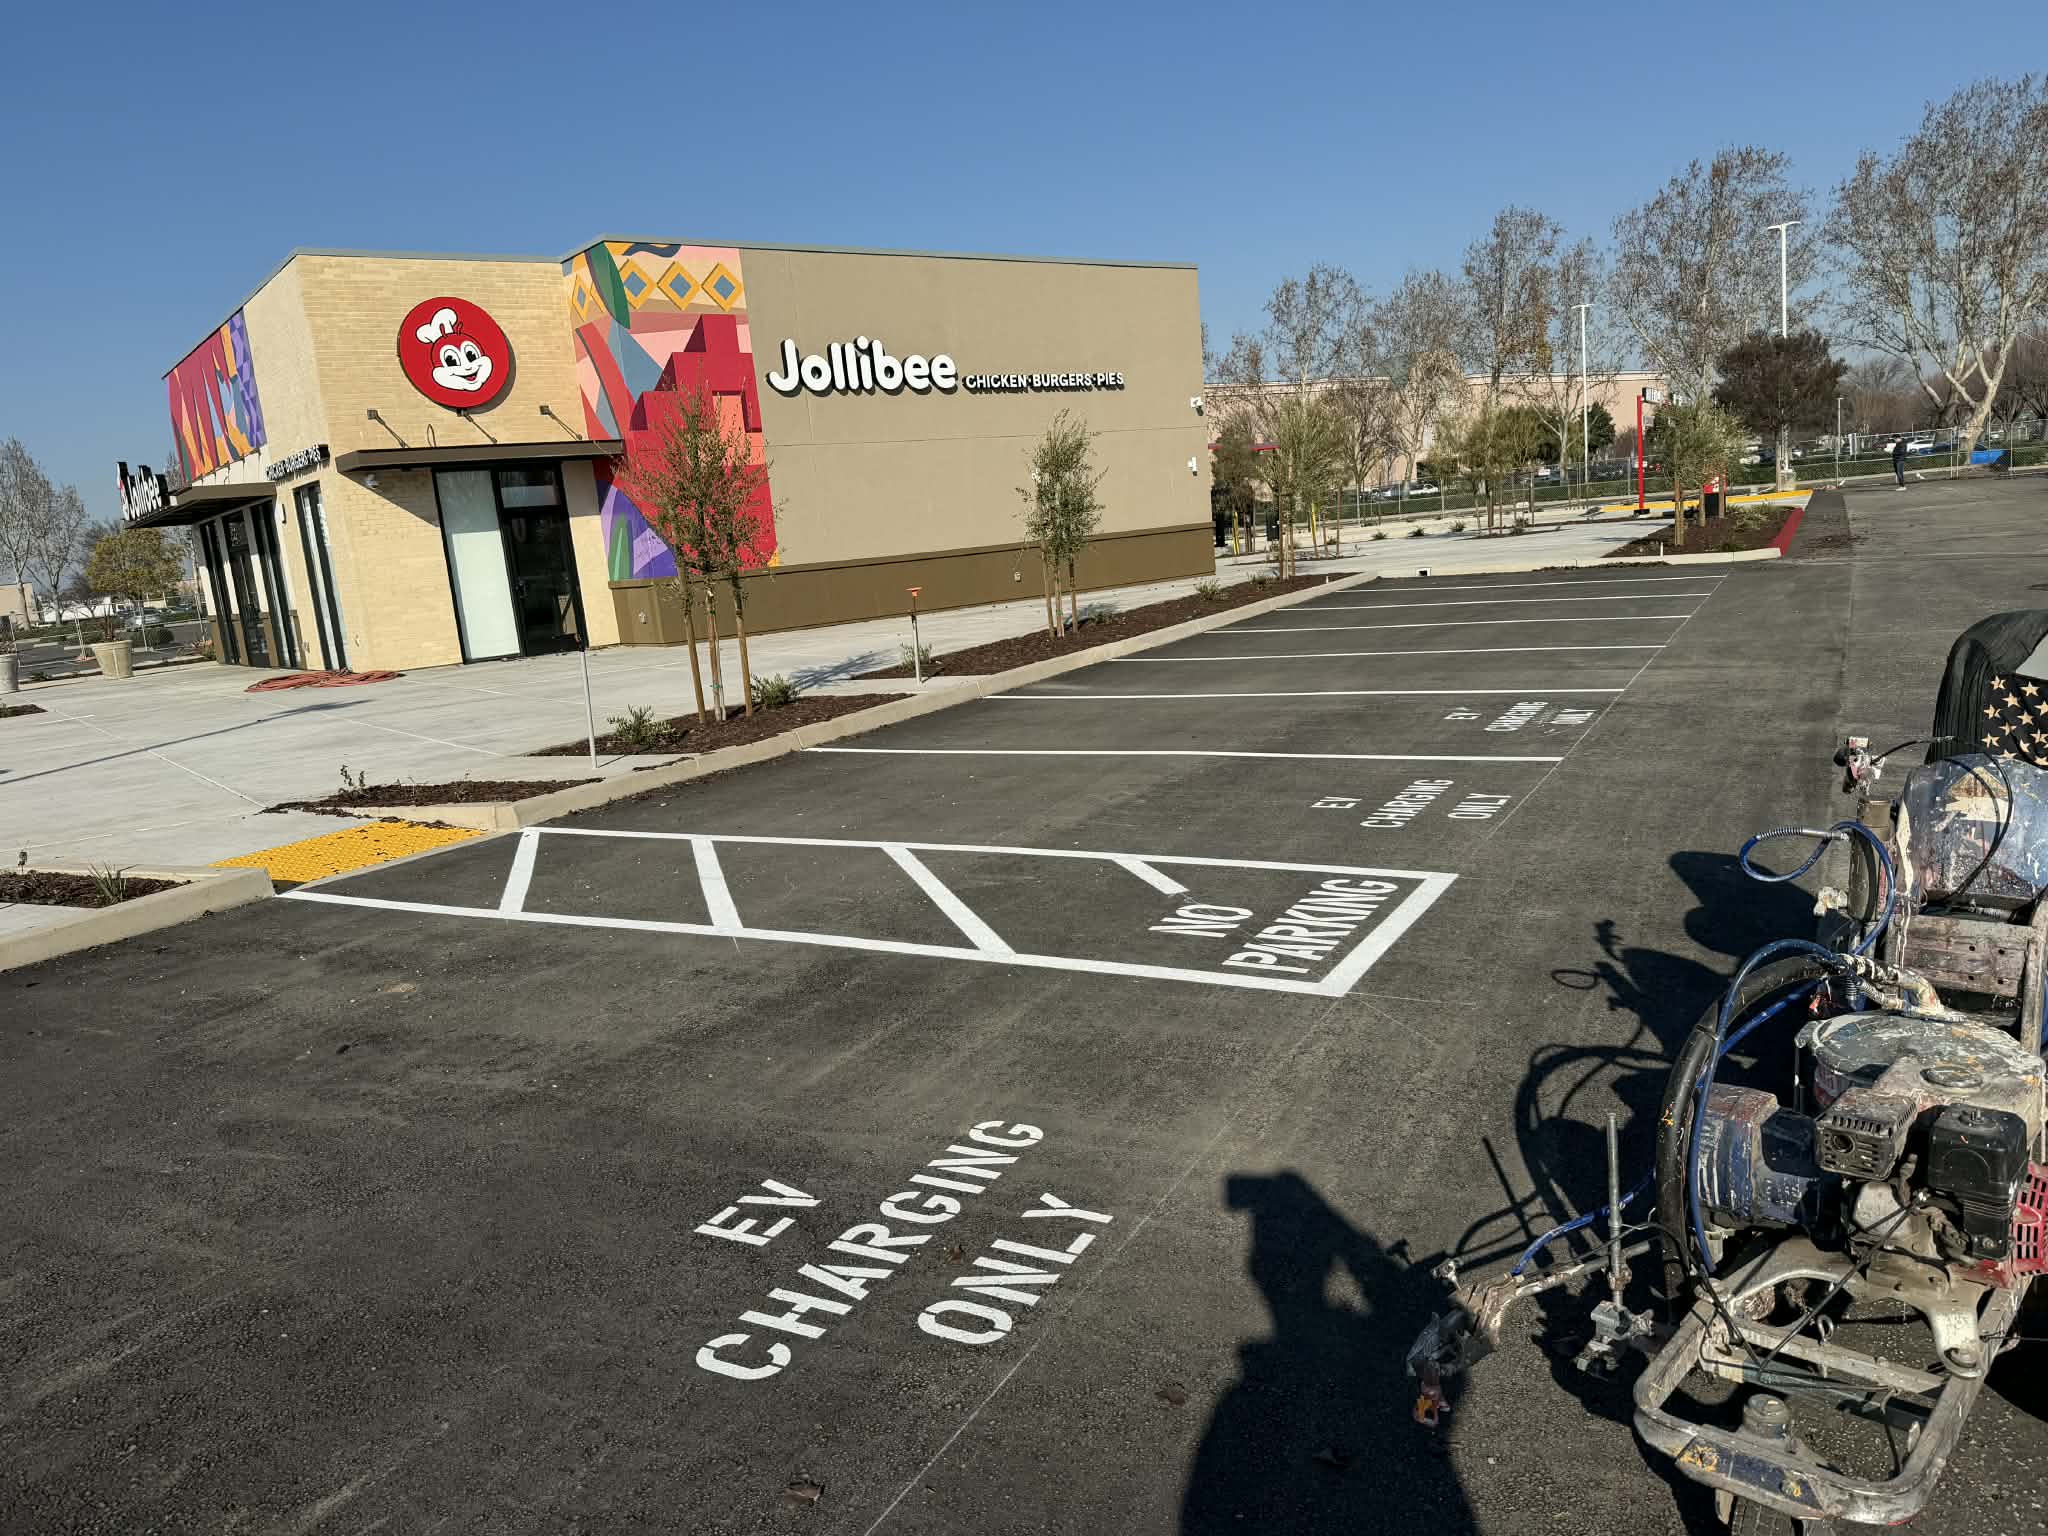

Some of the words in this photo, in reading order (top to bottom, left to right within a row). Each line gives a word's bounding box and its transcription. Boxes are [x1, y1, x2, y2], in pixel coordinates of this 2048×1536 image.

[768, 335, 957, 392] Jollibee
[965, 374, 1027, 388] CHICKEN
[1032, 374, 1092, 387] BURGERS
[1097, 372, 1124, 386] PIES
[1311, 796, 1363, 809] EV
[1360, 778, 1455, 828] CHARGING
[1447, 792, 1512, 819] ONLY
[1147, 903, 1254, 938] NO
[1222, 879, 1399, 974] PARKING
[694, 1178, 822, 1247] EV
[695, 1119, 1044, 1380] CHARGING
[917, 1192, 1114, 1344] ONLY
